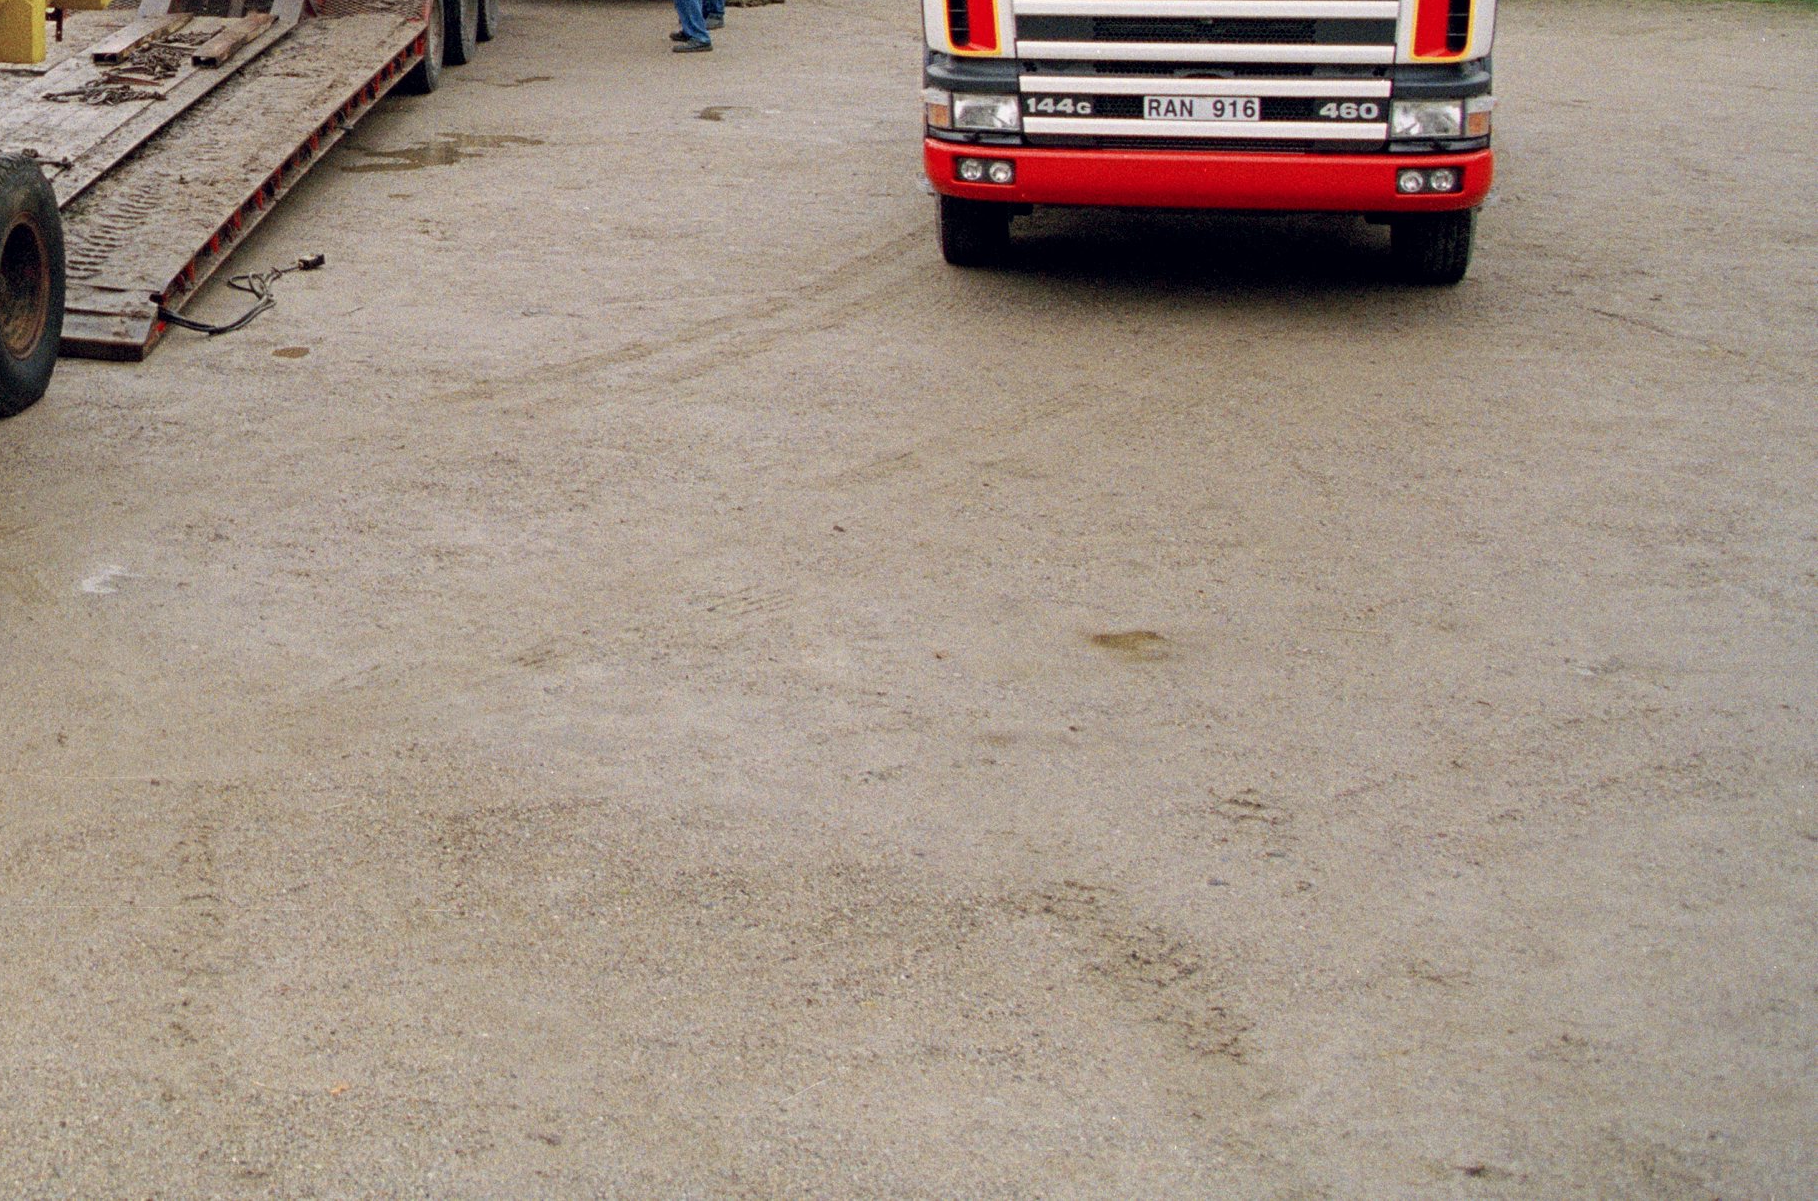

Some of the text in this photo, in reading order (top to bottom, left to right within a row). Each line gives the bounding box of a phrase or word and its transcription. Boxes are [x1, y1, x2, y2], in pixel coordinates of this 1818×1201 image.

[1147, 98, 1257, 119] RAN 916
[1319, 103, 1379, 119] 460
